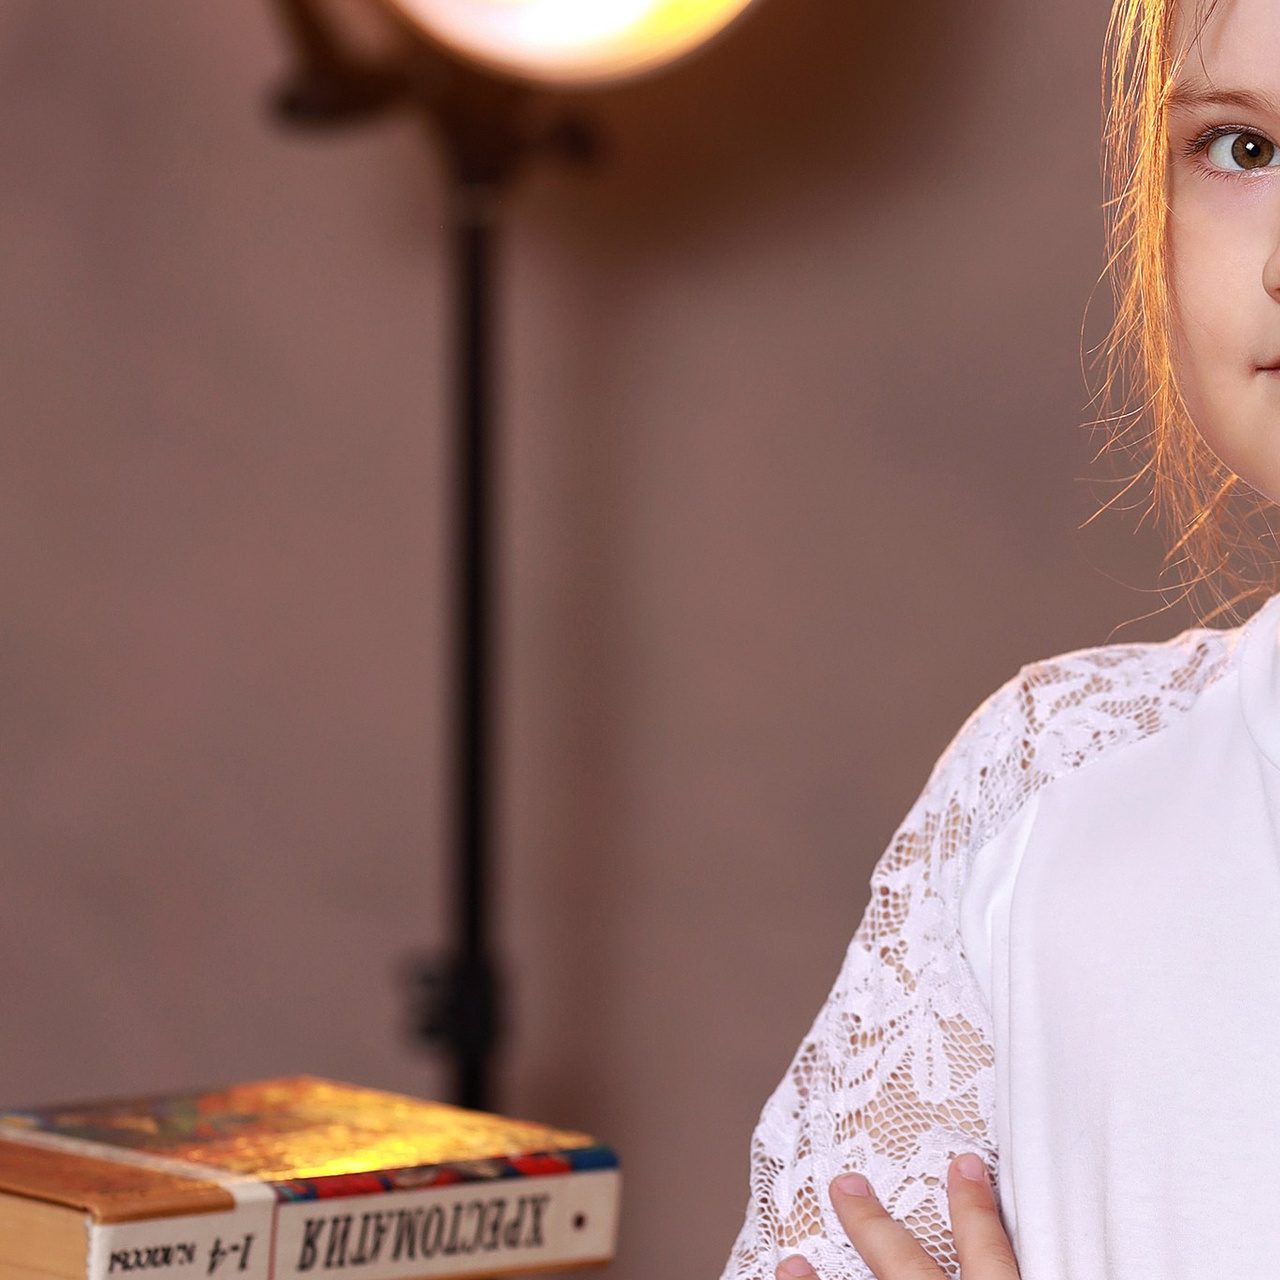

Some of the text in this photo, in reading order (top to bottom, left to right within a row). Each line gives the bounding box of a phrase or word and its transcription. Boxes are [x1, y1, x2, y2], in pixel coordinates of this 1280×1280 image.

[108, 1234, 254, 1276] 1-4 классы
[298, 1193, 550, 1270] ХРЕСТОМАТИЯ
